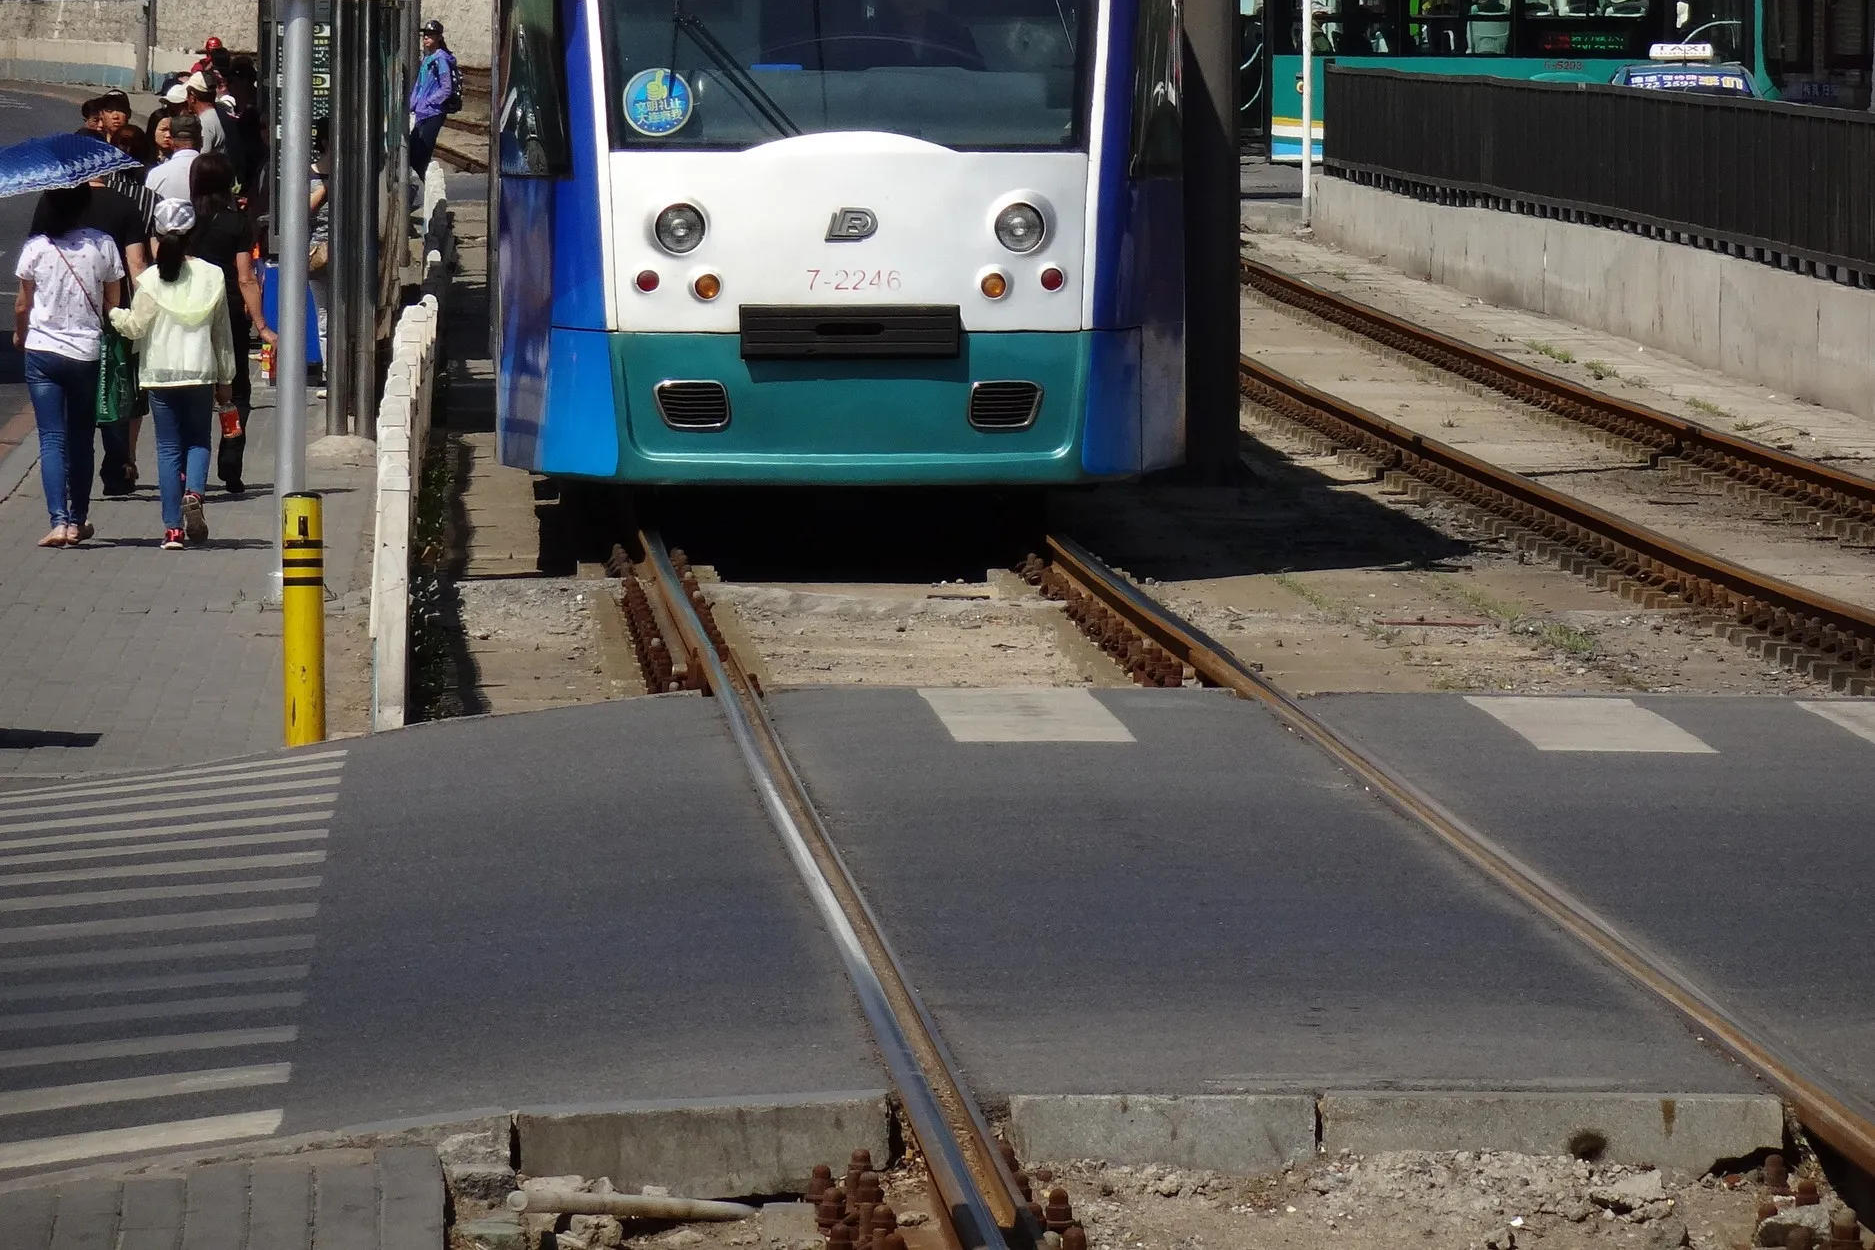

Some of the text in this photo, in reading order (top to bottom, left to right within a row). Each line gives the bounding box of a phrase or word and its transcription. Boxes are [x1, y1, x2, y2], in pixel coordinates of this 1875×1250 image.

[635, 98, 682, 113] 文明礼让
[637, 109, 684, 125] 大连有我
[806, 269, 902, 291] 7-2246
